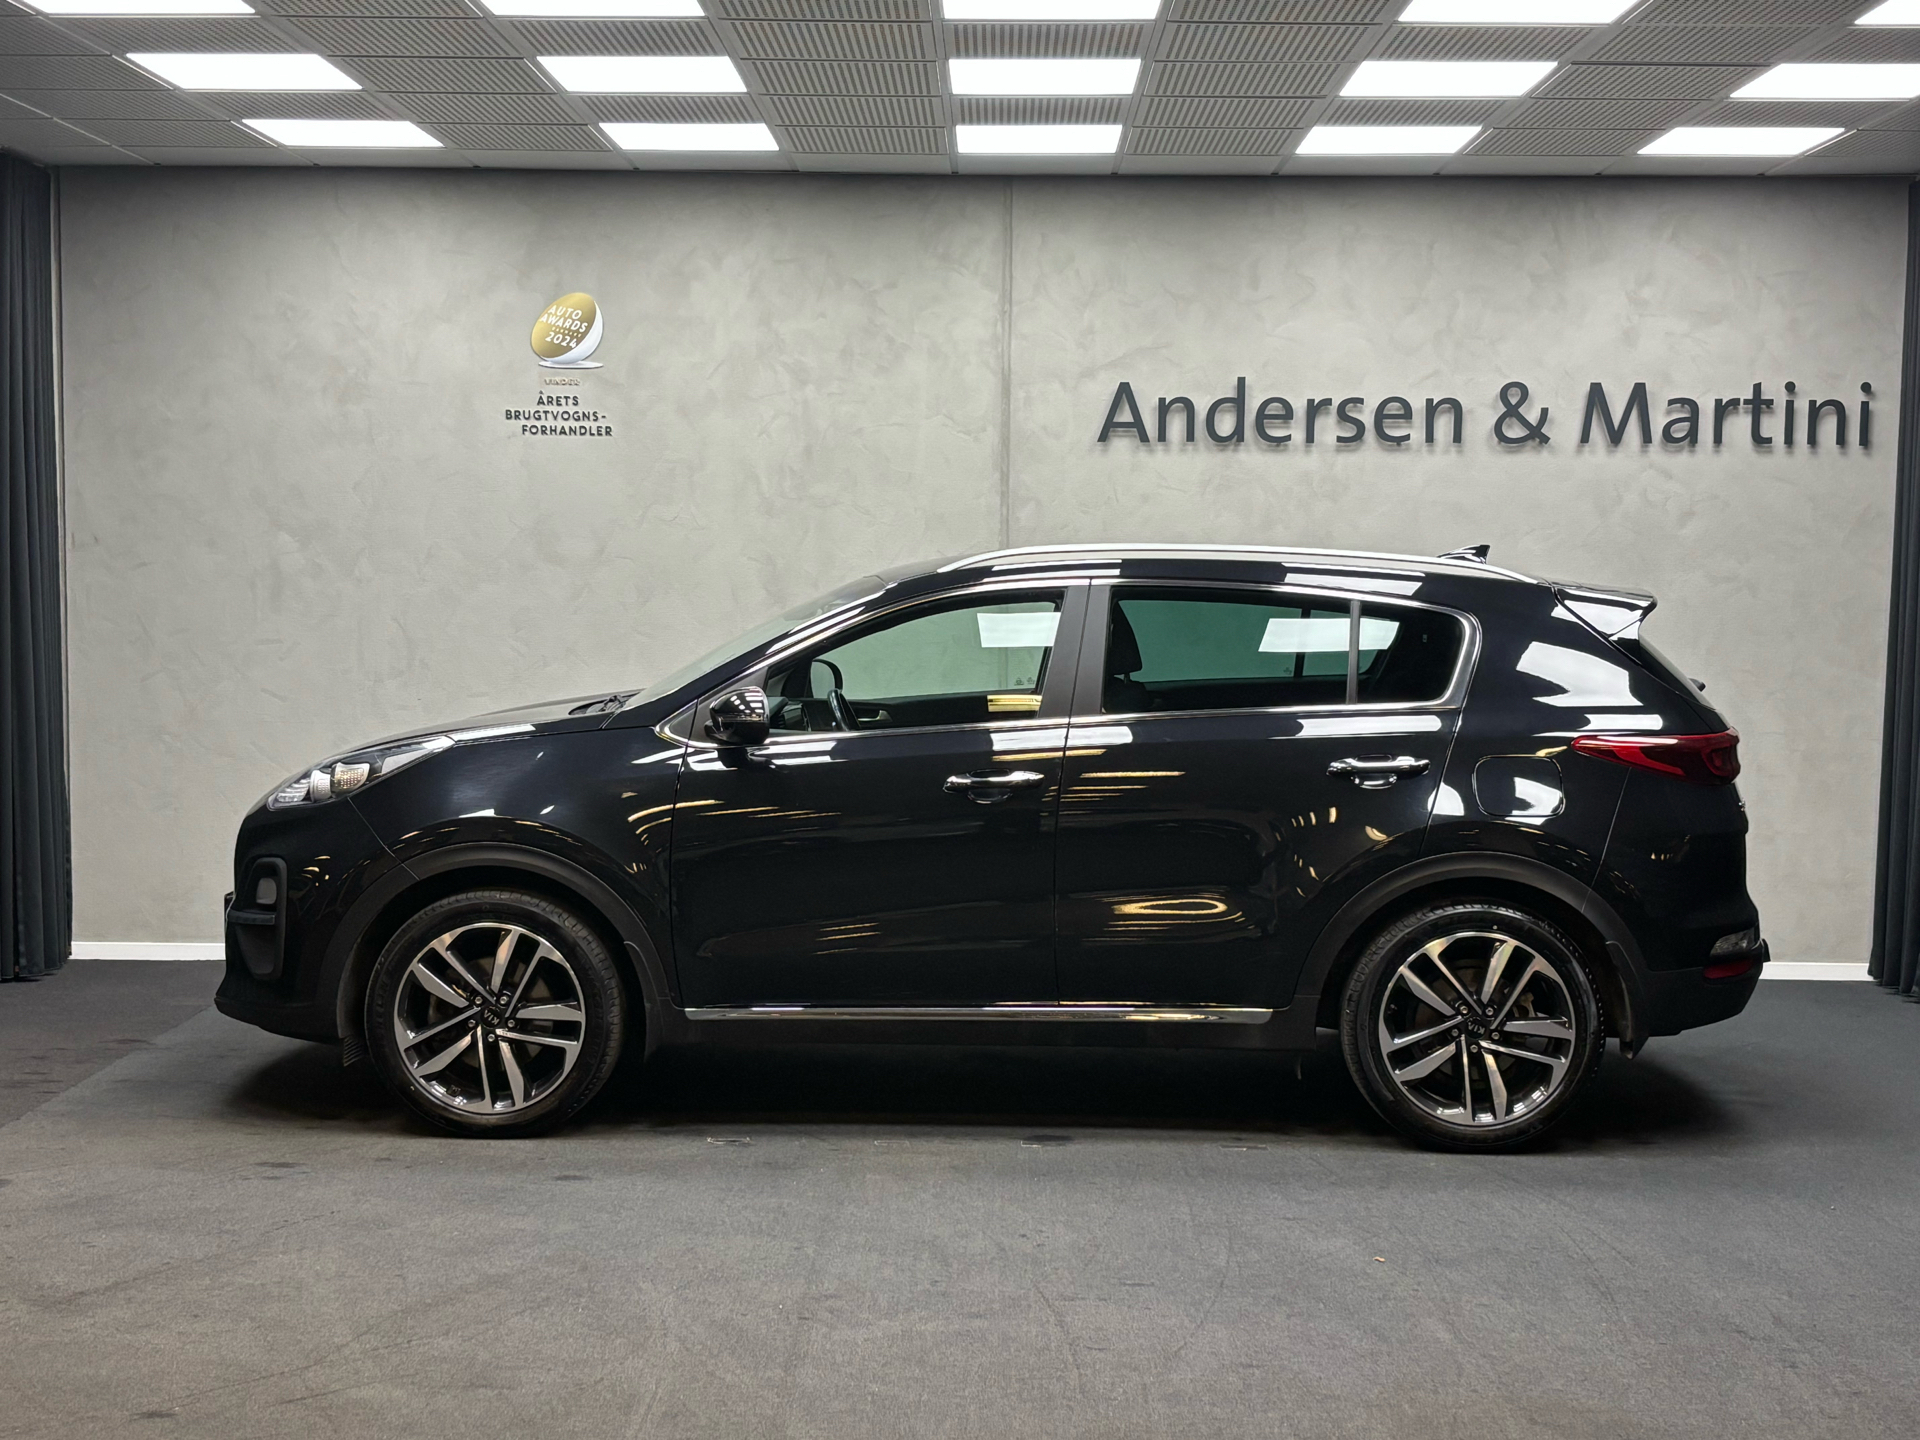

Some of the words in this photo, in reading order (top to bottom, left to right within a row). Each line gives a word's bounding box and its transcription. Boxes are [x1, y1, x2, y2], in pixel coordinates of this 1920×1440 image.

[548, 305, 582, 320] AUTO
[540, 313, 588, 332] AWARDS
[544, 332, 577, 348] 2024
[537, 390, 579, 407] ÅRETS
[505, 409, 606, 422] BRUGTVOGNS-
[1097, 377, 1463, 444] Andersen
[1494, 381, 1550, 445] &
[1580, 381, 1871, 447] Martini
[522, 424, 613, 437] FORHANDLER
